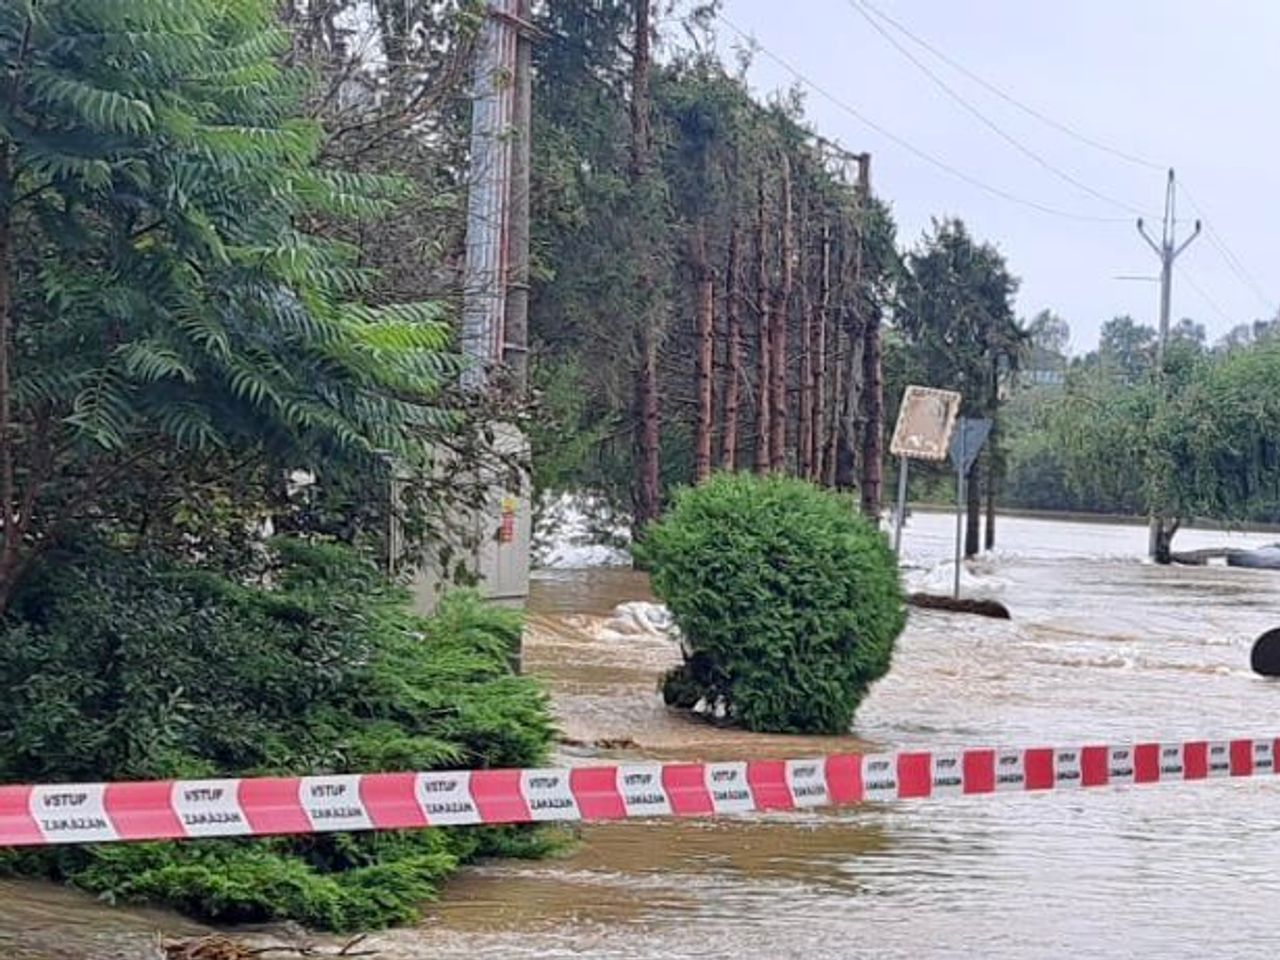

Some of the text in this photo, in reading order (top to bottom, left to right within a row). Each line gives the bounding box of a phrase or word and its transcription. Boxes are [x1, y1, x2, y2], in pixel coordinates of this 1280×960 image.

[310, 784, 347, 798] VSTUP
[424, 780, 457, 793] VSTUP
[43, 793, 88, 807] VSTUP
[183, 788, 224, 802] VSTUP
